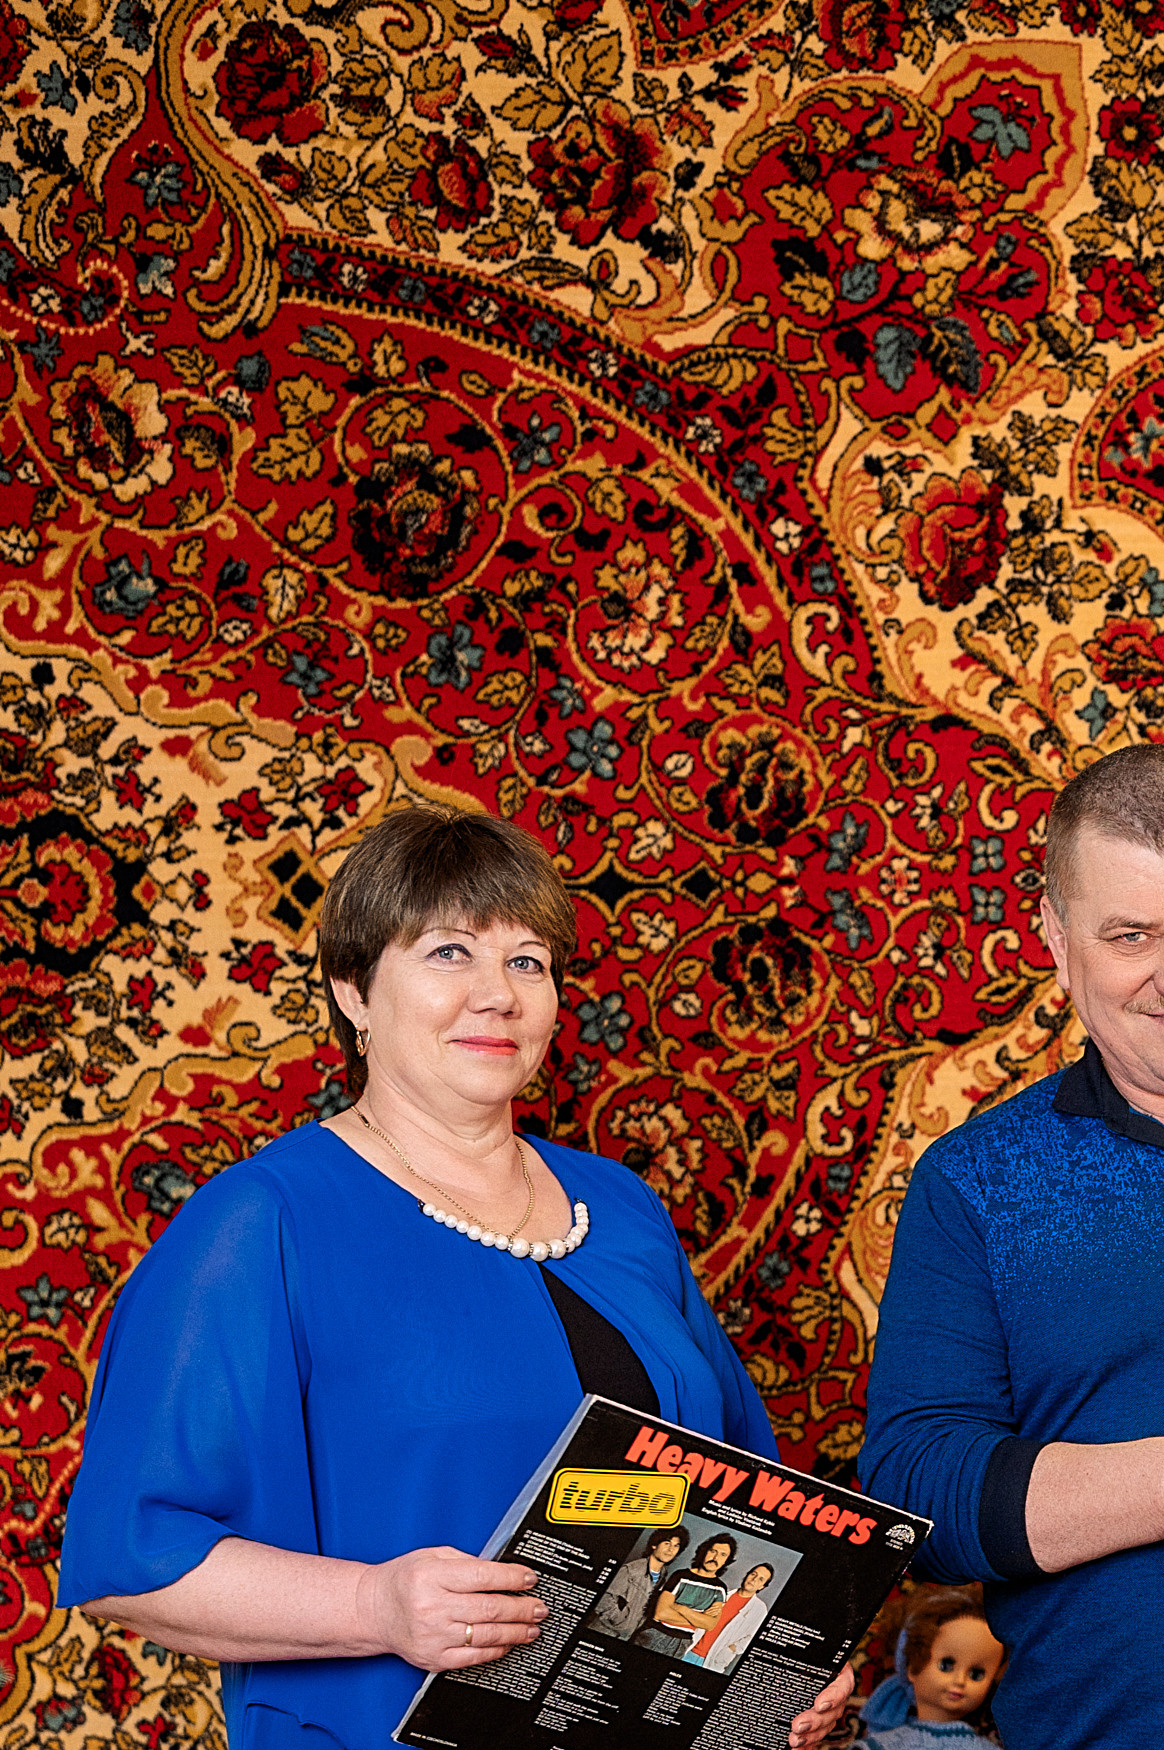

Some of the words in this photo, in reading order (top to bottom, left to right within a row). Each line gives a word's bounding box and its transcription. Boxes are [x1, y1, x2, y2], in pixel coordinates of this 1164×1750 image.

[560, 1478, 678, 1517] turbo
[625, 1426, 749, 1502] Heavy
[749, 1470, 877, 1544] Waters
